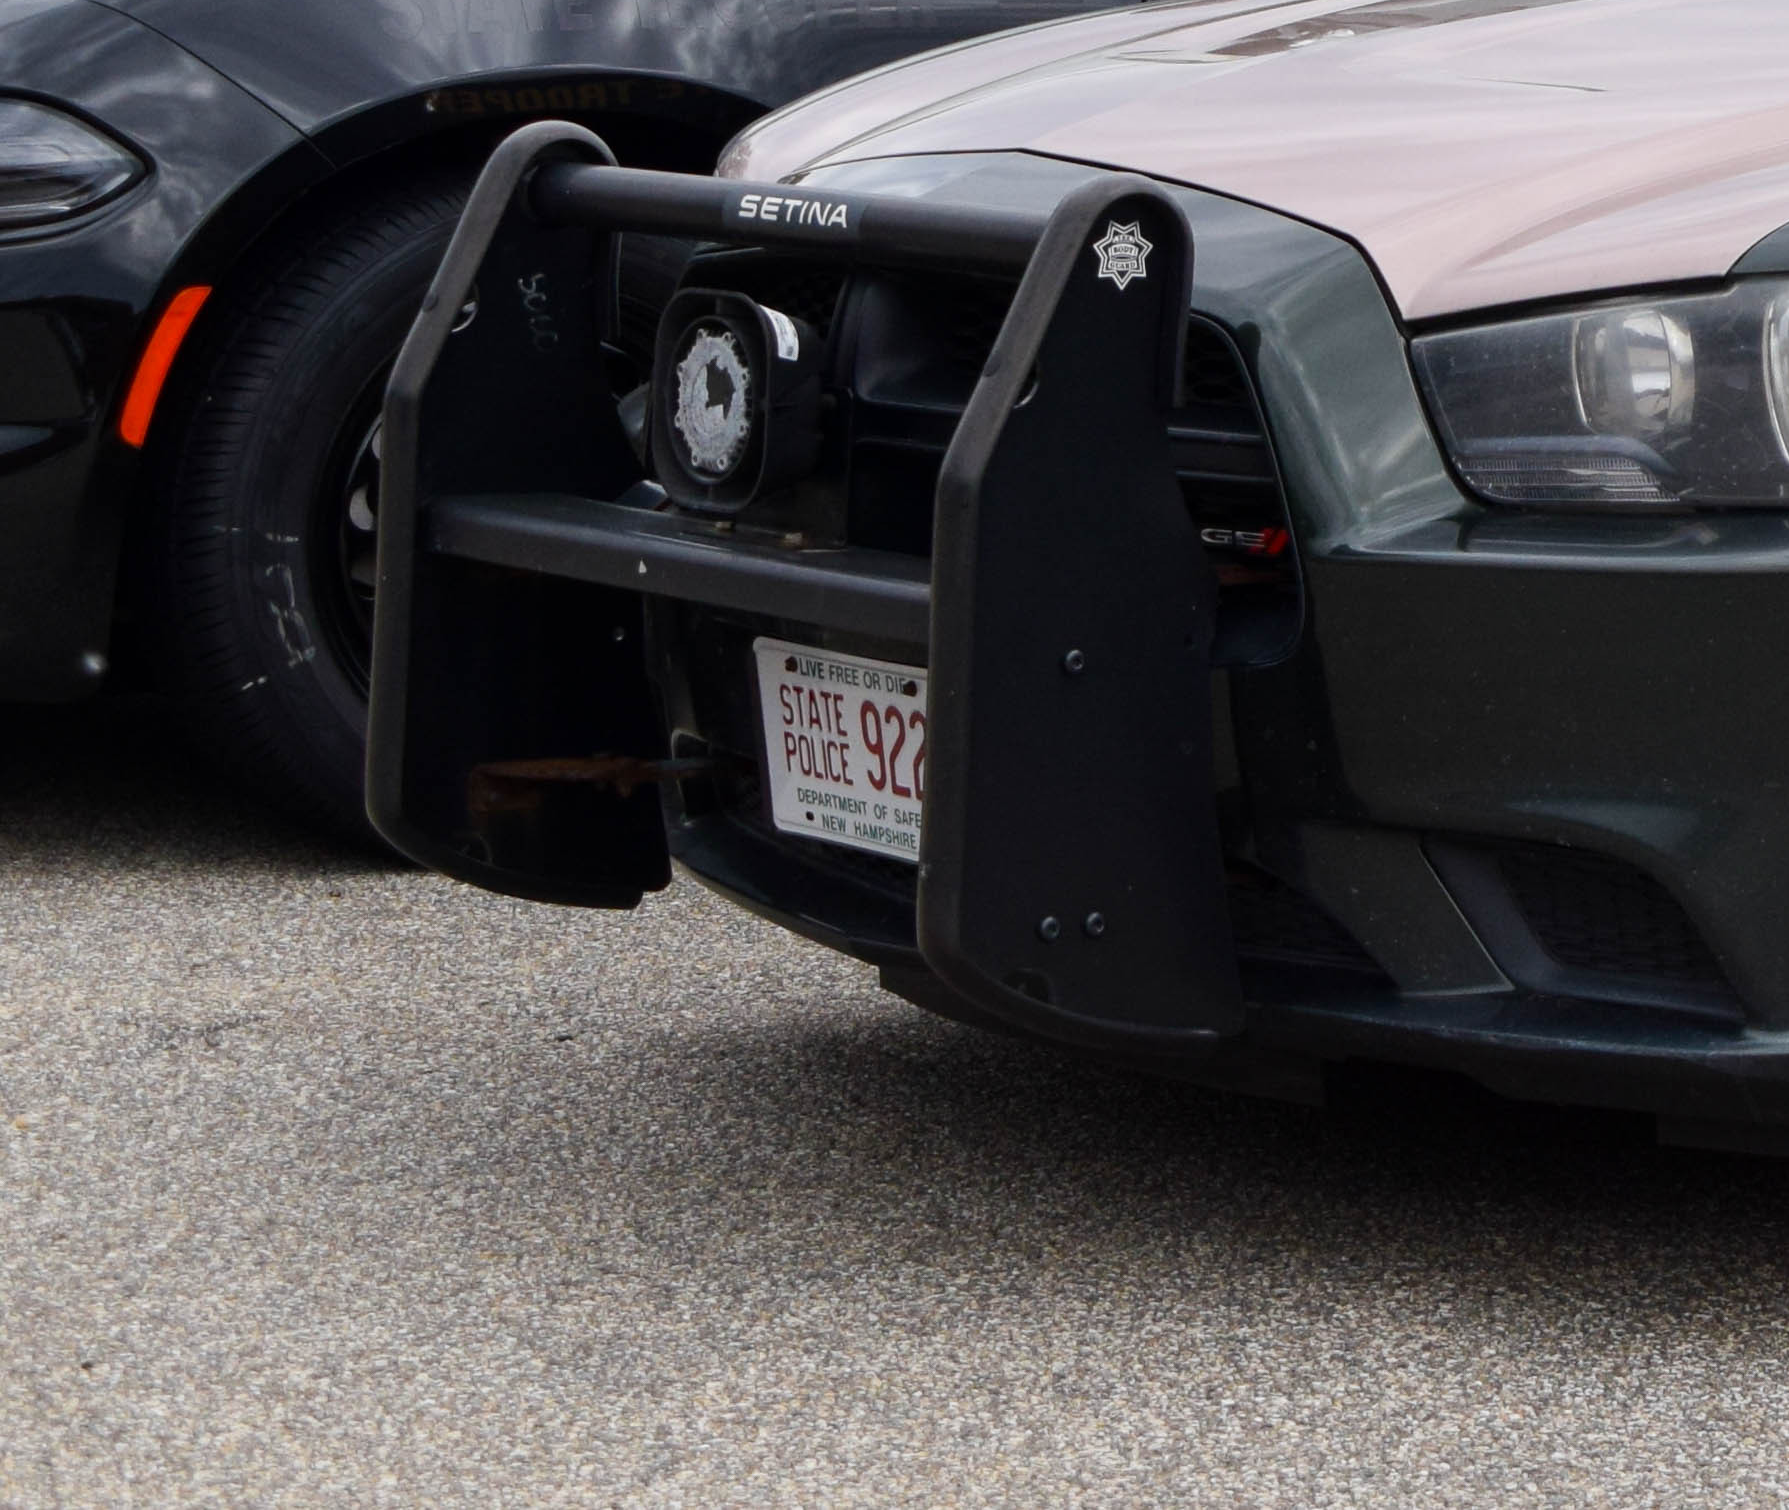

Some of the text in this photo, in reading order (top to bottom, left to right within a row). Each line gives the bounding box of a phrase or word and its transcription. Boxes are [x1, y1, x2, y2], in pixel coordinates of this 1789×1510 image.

[738, 194, 848, 228] SETINA
[799, 657, 825, 680] LIVE
[829, 664, 860, 687] FREE
[863, 672, 881, 691] OR
[780, 684, 848, 737] STATE
[783, 731, 854, 786] POLICE
[797, 788, 868, 814] DEPARTMENT
[874, 804, 888, 820] OF
[822, 813, 917, 850] NEW HAMPSHIRE
